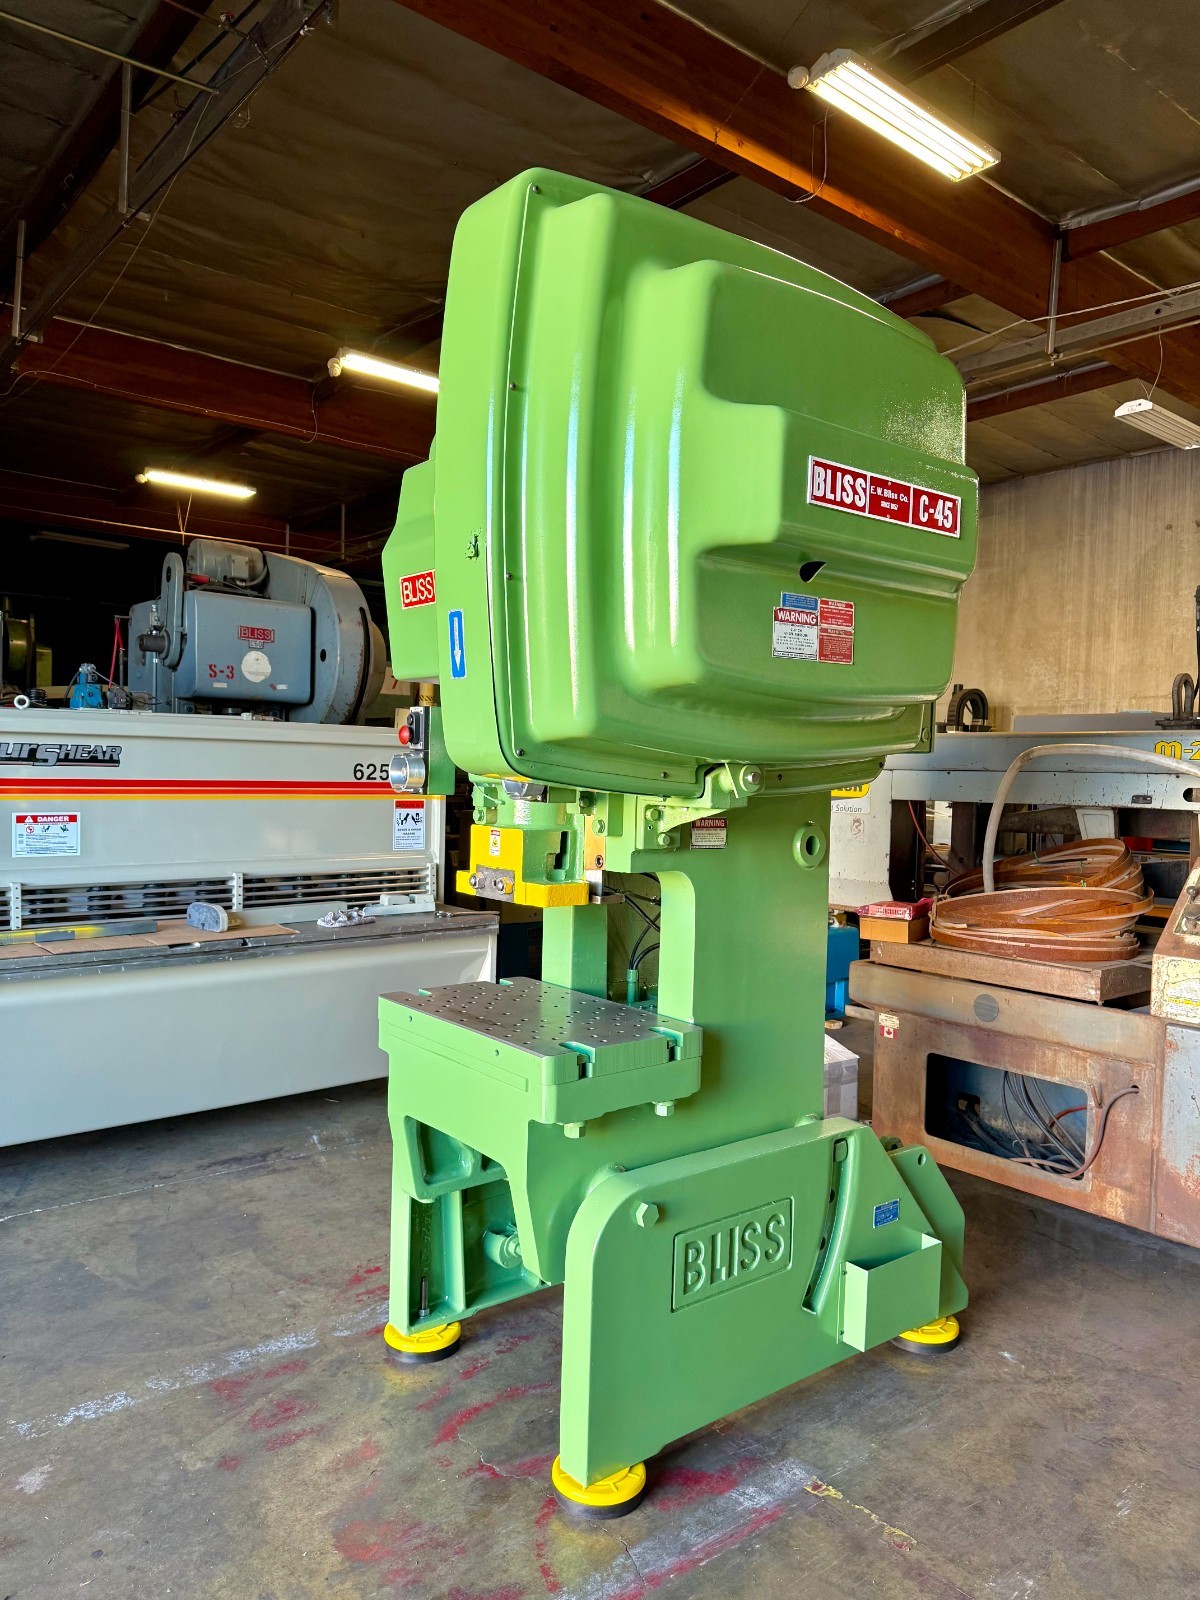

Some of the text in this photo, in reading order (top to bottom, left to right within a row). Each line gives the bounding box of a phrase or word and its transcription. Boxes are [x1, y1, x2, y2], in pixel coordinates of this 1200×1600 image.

[812, 465, 867, 508] BLISS
[918, 494, 953, 529] C-45
[402, 576, 434, 604] BLISS
[778, 609, 817, 624] WARNING
[241, 627, 271, 640] BLISS
[208, 663, 235, 680] S-3
[696, 819, 725, 827] WARNING
[684, 1213, 785, 1296] BLISS
